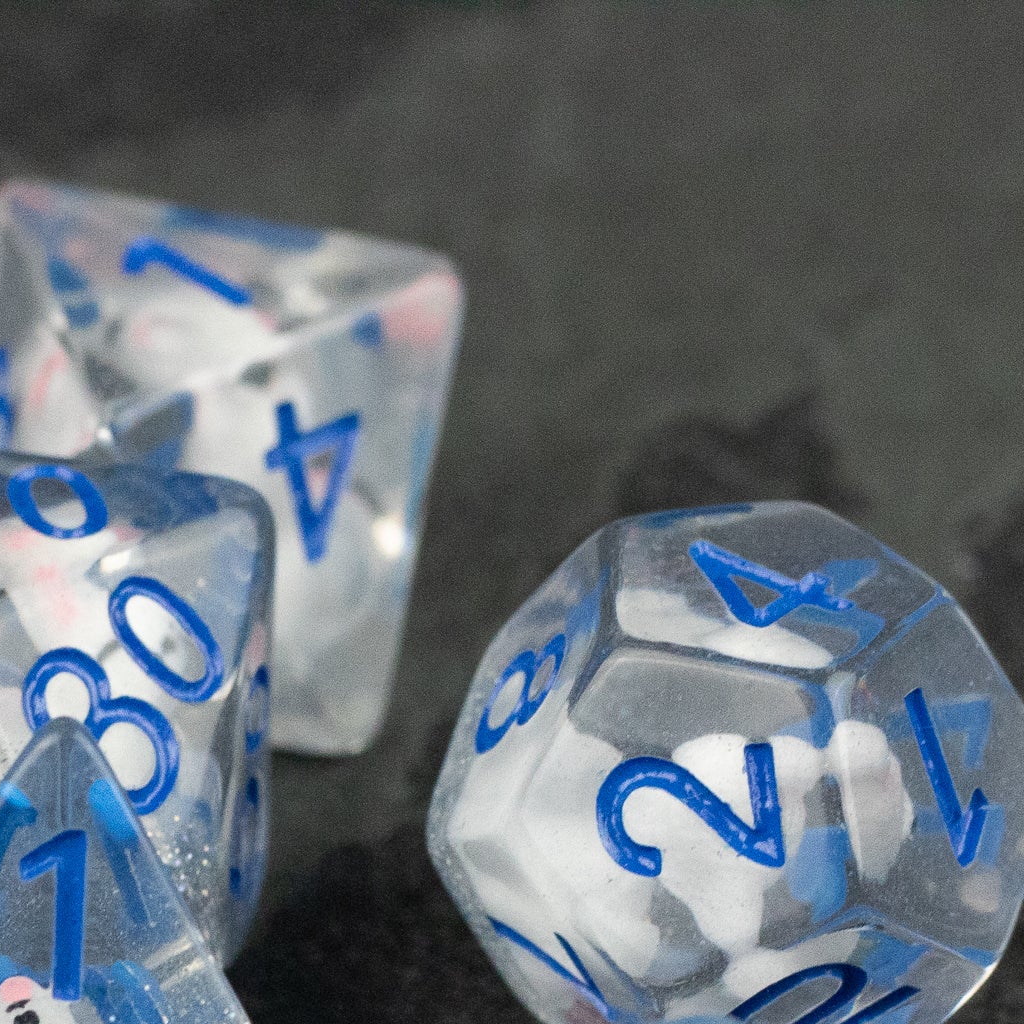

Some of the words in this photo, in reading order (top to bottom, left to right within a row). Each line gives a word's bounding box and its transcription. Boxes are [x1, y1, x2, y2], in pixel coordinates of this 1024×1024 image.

[121, 236, 254, 307] 1
[264, 400, 362, 564] 4
[688, 540, 856, 628] 4
[22, 574, 225, 816] 80
[474, 632, 568, 755] 8
[595, 742, 786, 878] 2
[903, 686, 988, 868] 1
[18, 829, 88, 1001] 1
